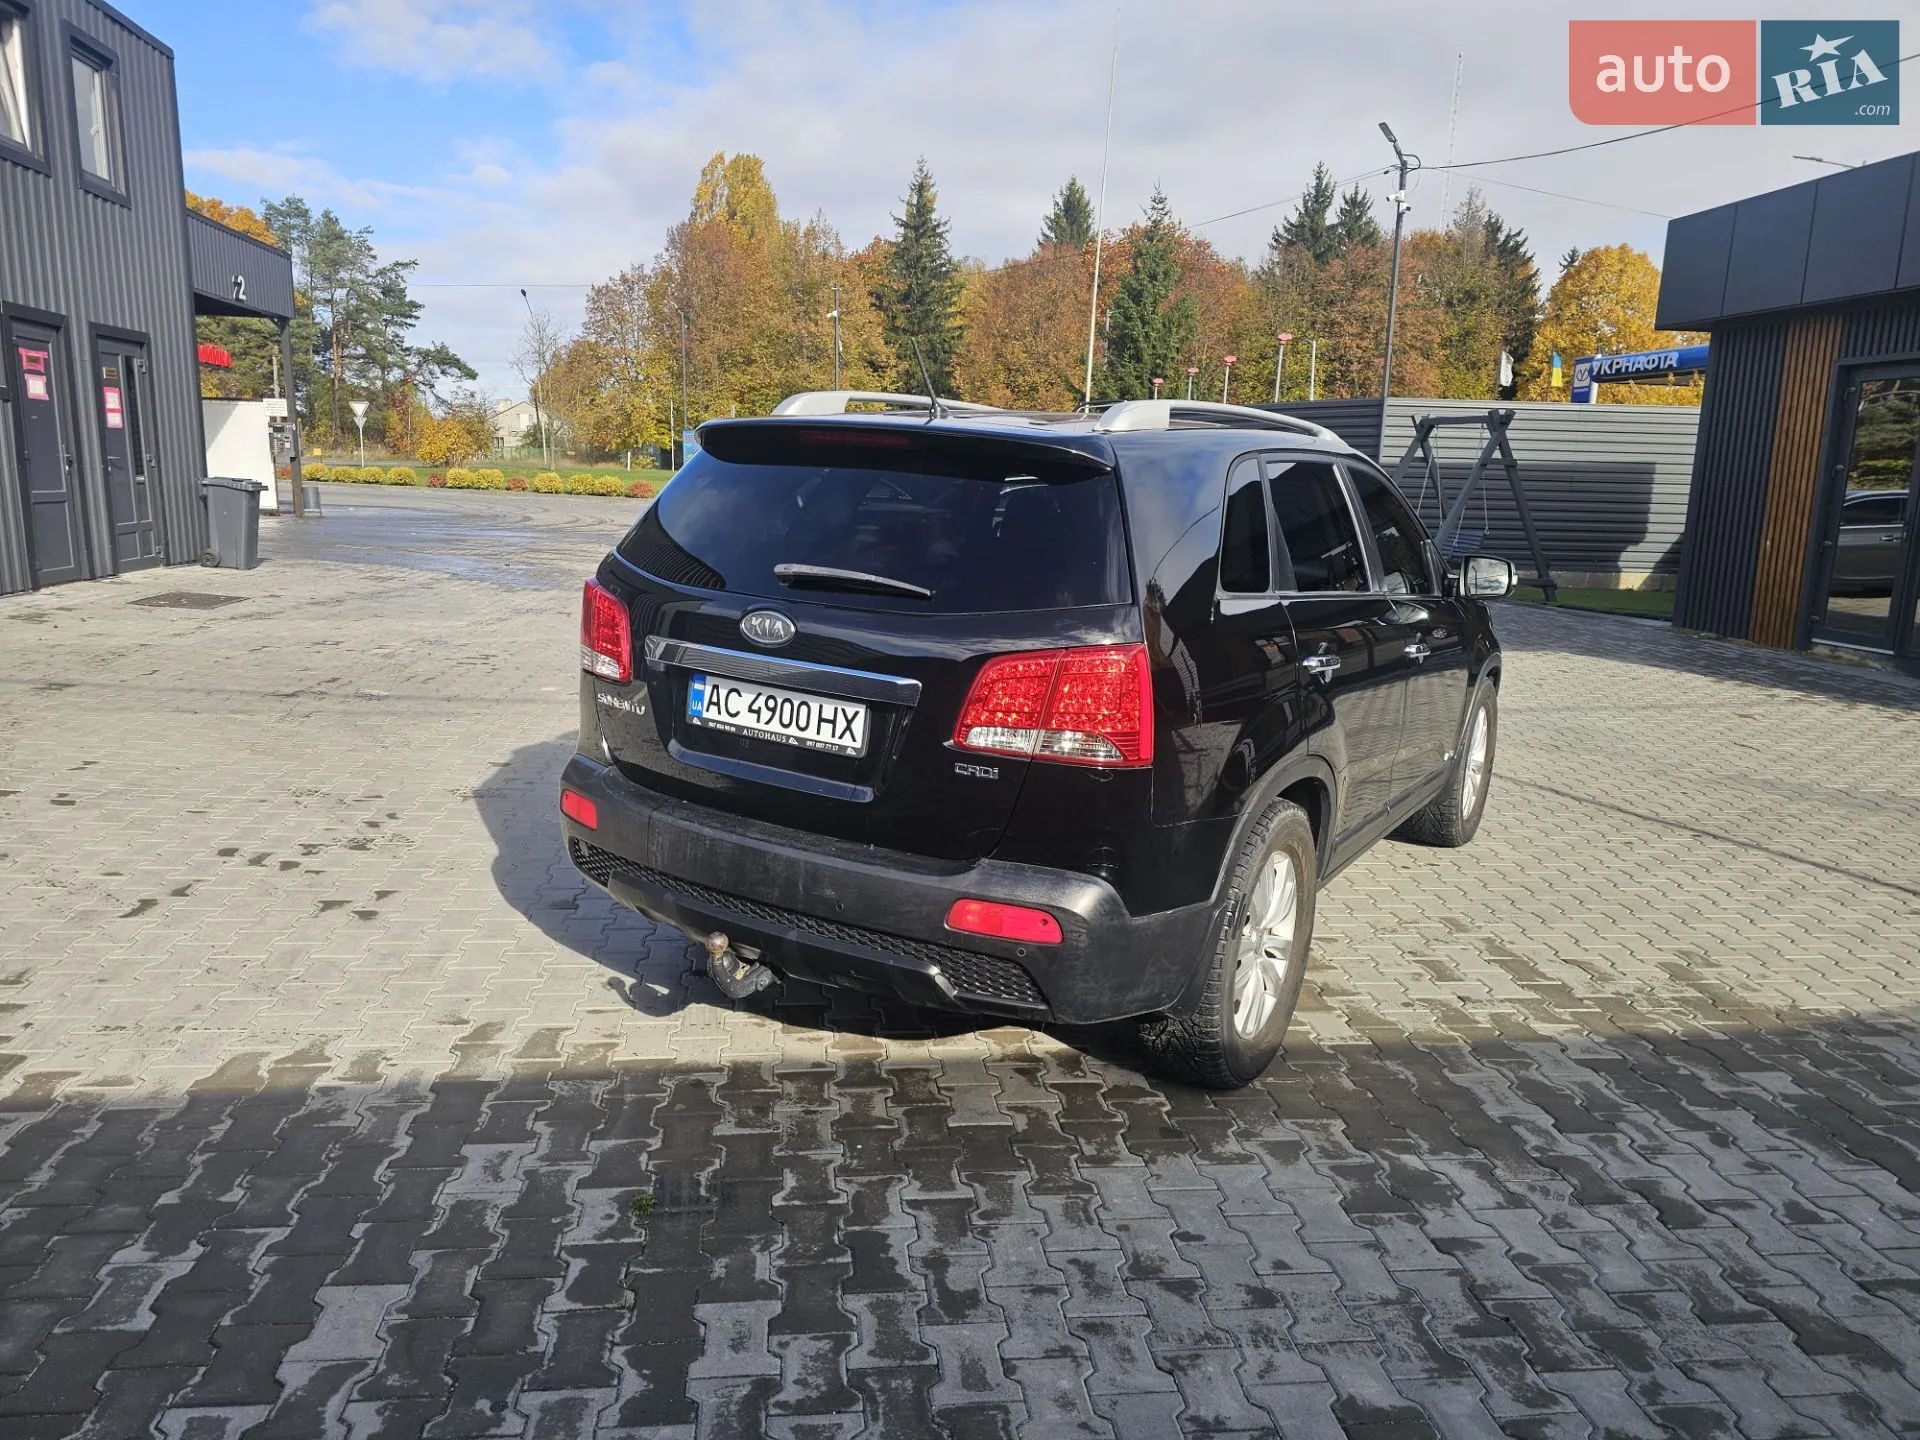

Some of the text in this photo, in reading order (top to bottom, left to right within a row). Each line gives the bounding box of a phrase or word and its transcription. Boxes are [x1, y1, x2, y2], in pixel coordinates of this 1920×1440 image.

[1591, 351, 1678, 376] УКРНАФТА
[751, 616, 785, 639] KIA
[692, 700, 703, 711] UA
[705, 683, 860, 743] AC 4900 HX
[742, 728, 787, 743] AUTOHAUS
